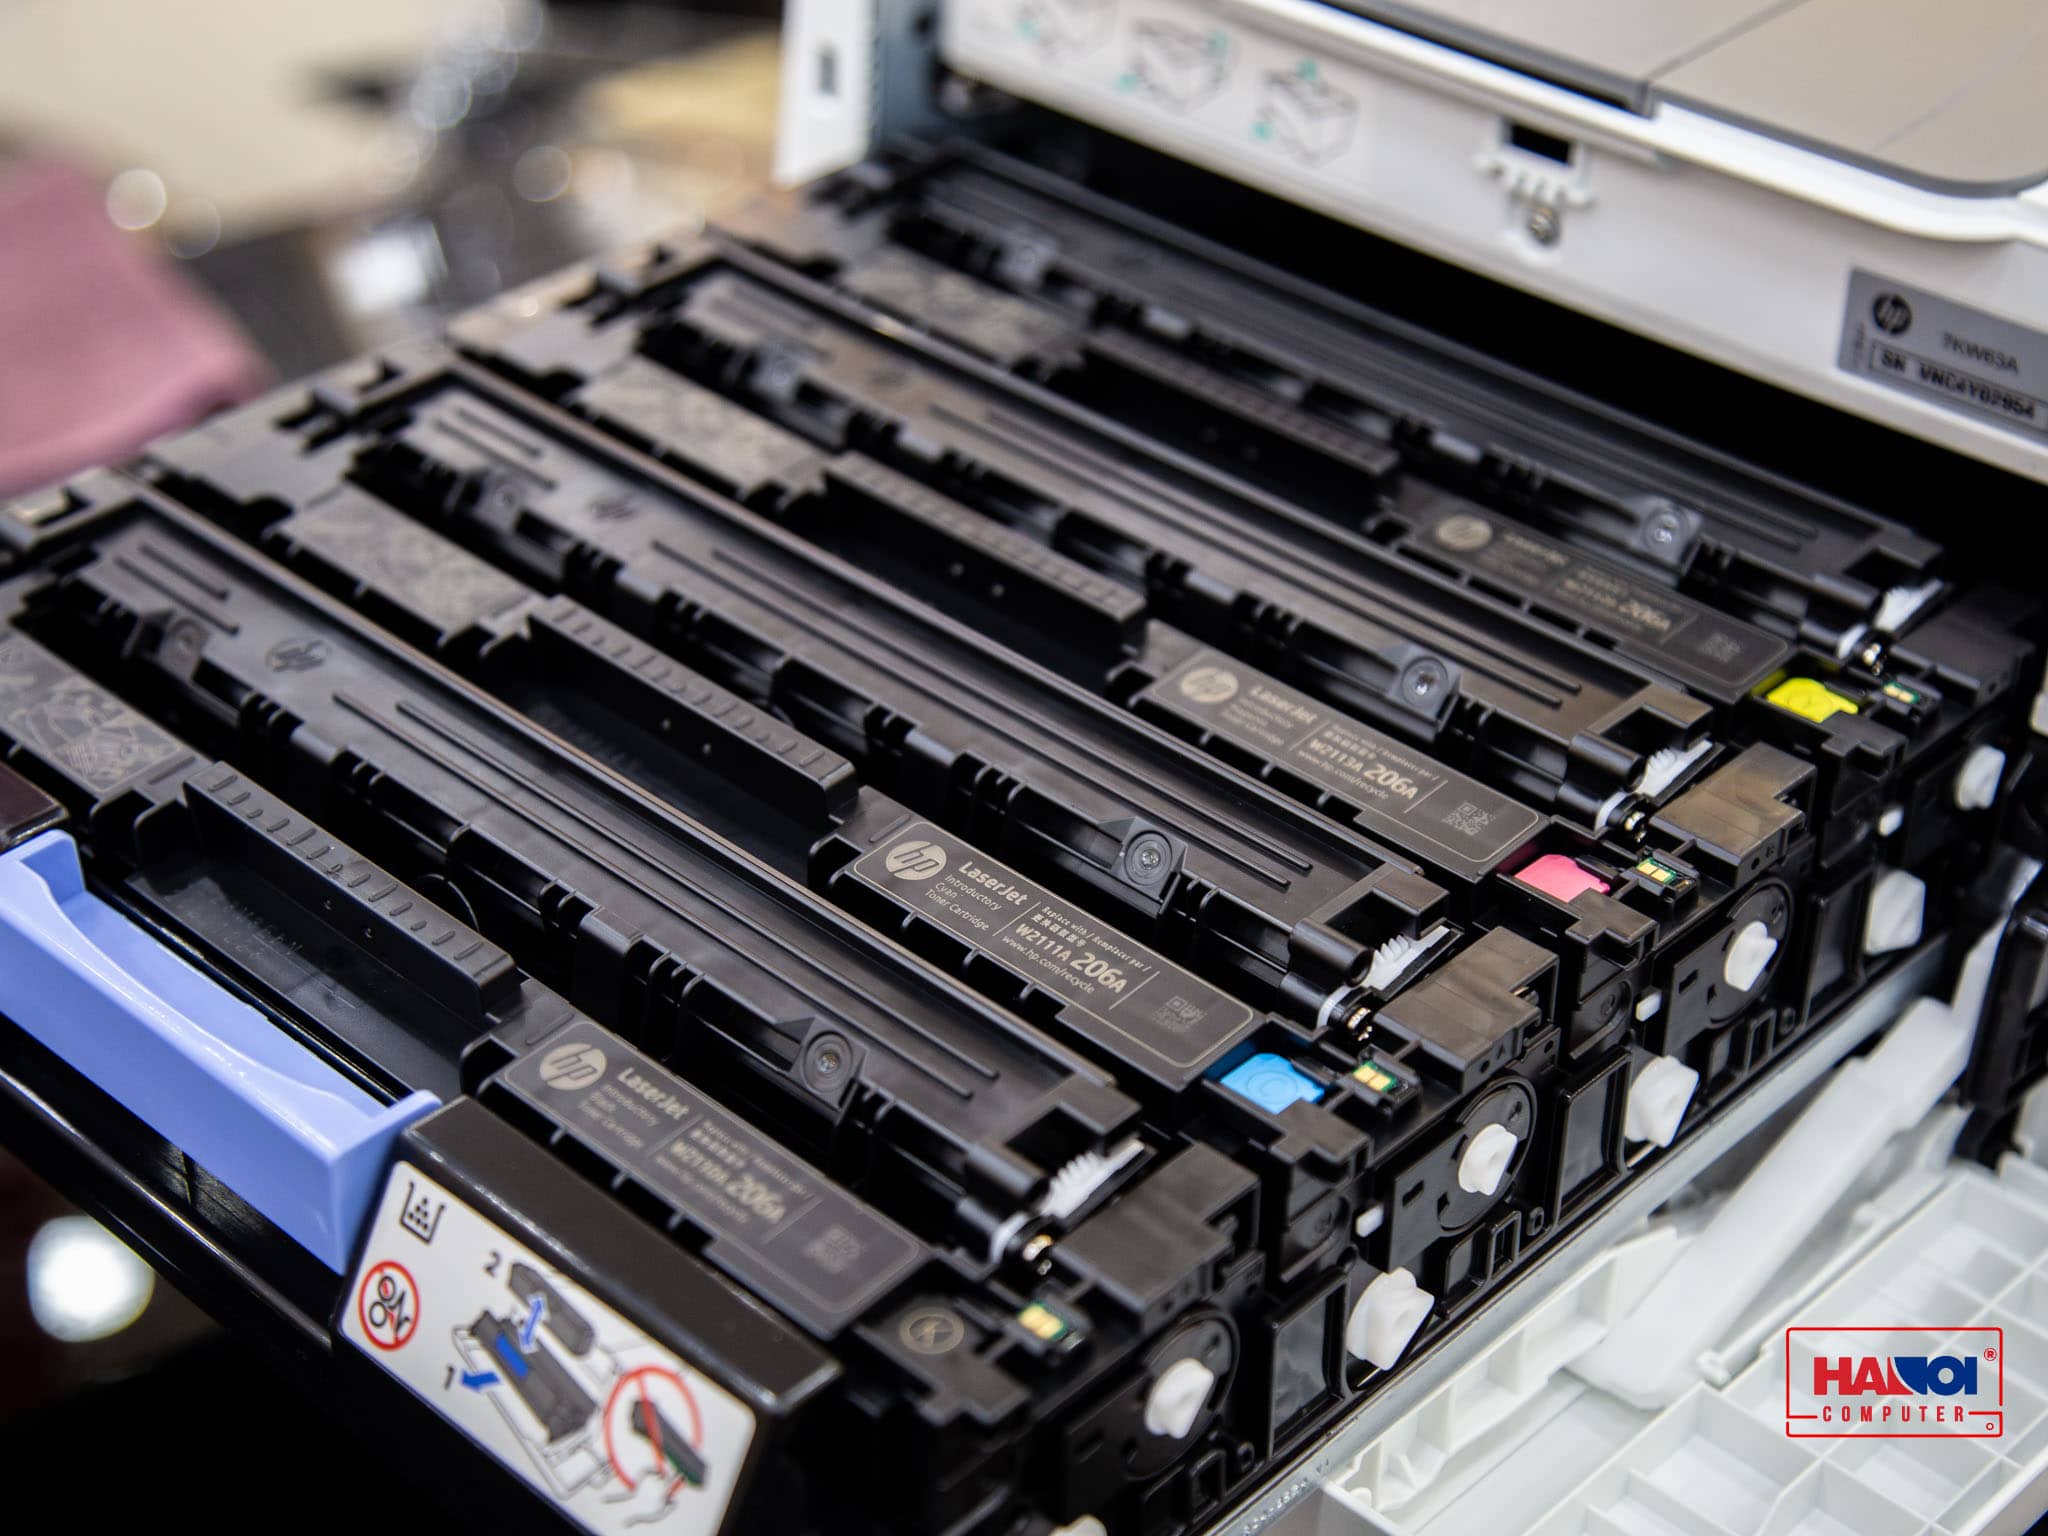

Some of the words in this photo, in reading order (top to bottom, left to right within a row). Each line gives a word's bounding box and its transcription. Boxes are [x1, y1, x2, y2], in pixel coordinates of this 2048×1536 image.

[1363, 763, 1419, 800] 206A
[885, 840, 947, 881] hp
[935, 882, 959, 901] Cyan
[944, 874, 1003, 912] Introductory
[958, 860, 1029, 906] LaserJet
[925, 889, 951, 907] Toner
[949, 903, 990, 931] Cartridge
[1042, 906, 1070, 927] Replace
[1002, 935, 1096, 994] www.hp.com/recycle
[1015, 923, 1073, 962] W2111A
[1069, 951, 1129, 994] 206A
[539, 1043, 608, 1091] hp
[616, 1066, 690, 1121] LaserJet
[483, 1250, 502, 1278] 2
